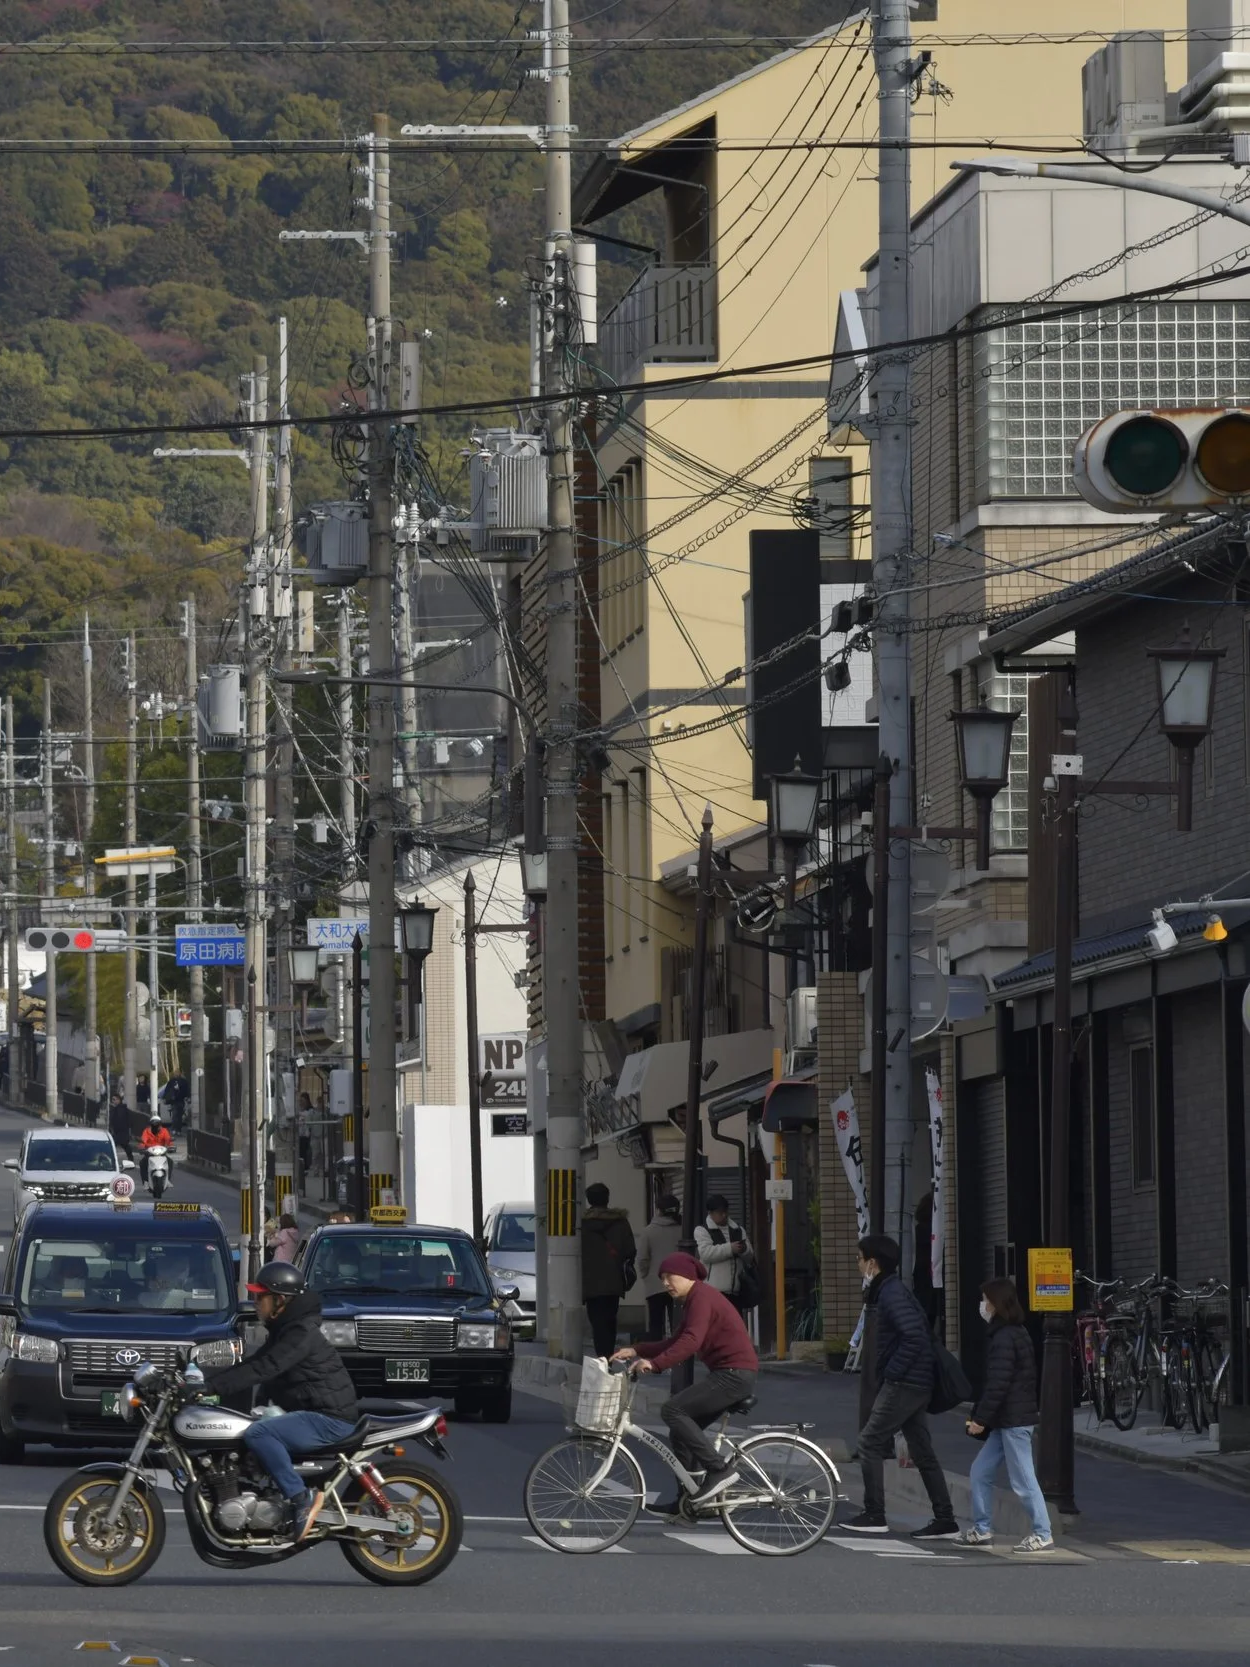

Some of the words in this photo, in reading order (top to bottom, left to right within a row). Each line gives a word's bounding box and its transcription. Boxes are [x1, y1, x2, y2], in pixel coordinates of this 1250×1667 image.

[178, 926, 236, 936] 救急指定病院
[315, 923, 368, 939] 大和大路
[116, 1181, 129, 1194] 都
[181, 1203, 198, 1212] TAXI
[397, 1368, 427, 1380] 15-02
[185, 1422, 232, 1431] Kawasaki
